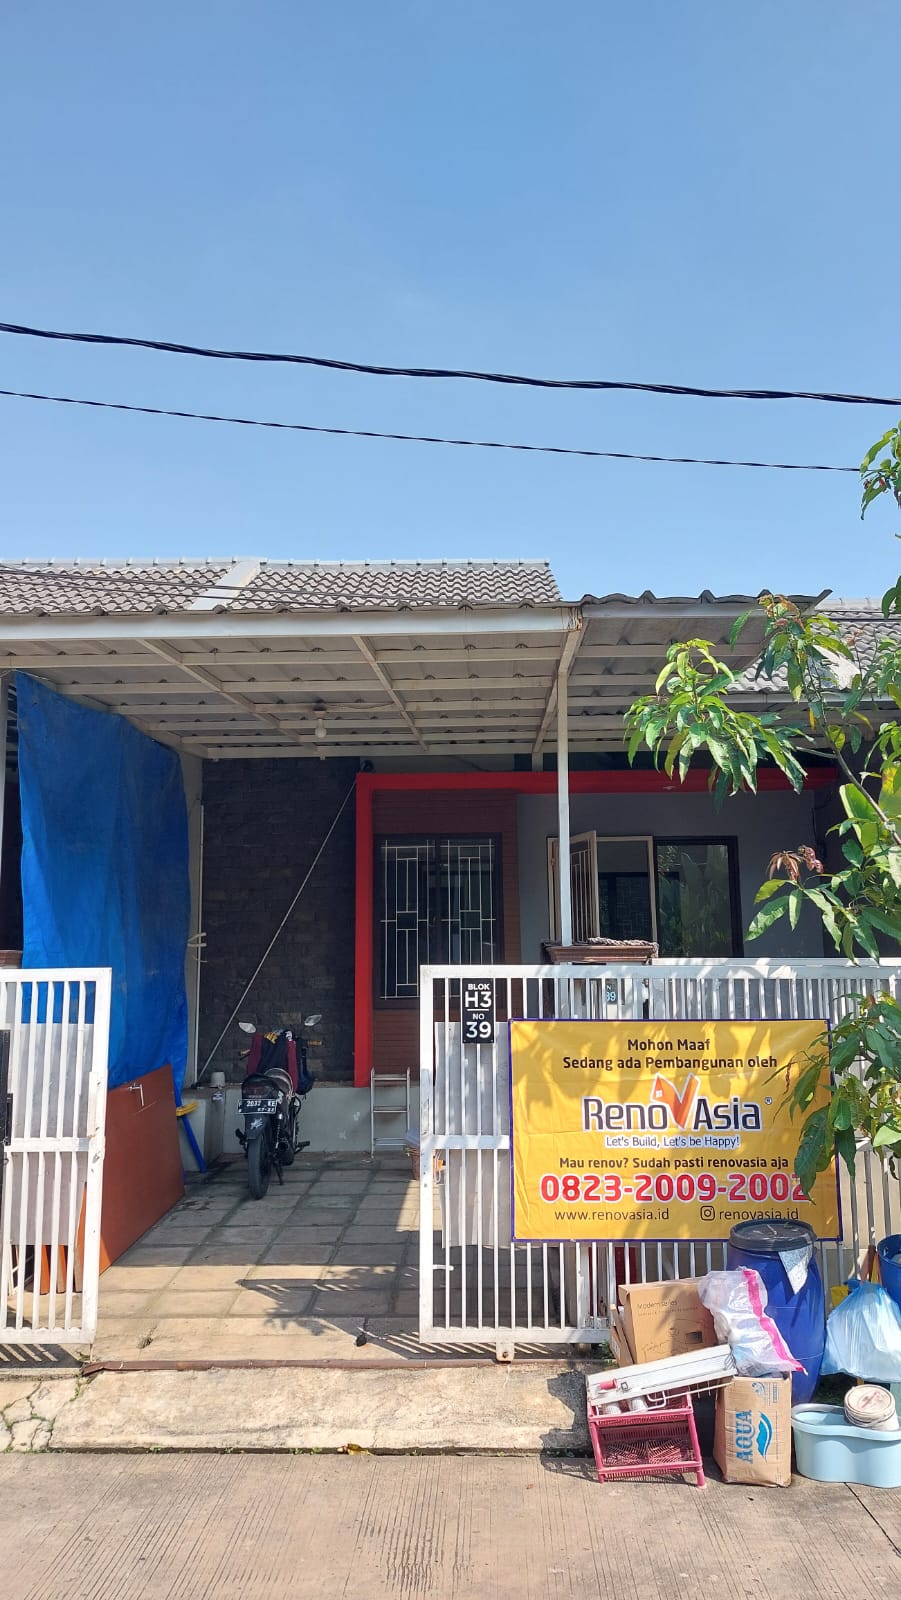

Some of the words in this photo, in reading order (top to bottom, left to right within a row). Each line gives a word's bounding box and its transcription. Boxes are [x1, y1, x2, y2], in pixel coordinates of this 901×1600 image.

[467, 983, 491, 991] BLOK
[464, 991, 492, 1008] H3
[466, 1021, 492, 1038] 39
[627, 1039, 673, 1051] Mohon
[677, 1039, 711, 1051] Maaf
[562, 1057, 613, 1071] Sedang
[617, 1057, 642, 1069] ada
[645, 1056, 744, 1070] Pembangunan
[747, 1056, 778, 1068] oleh
[606, 1136, 630, 1147] Let's
[632, 1136, 661, 1149] Build,
[663, 1136, 687, 1147] Let's
[689, 1136, 702, 1147] be
[704, 1136, 740, 1149] Happy!
[559, 1158, 585, 1169] Mau
[588, 1157, 629, 1169] renov?
[632, 1157, 671, 1169] Sudah
[674, 1157, 704, 1171] pasti
[707, 1157, 768, 1169] renovasia
[770, 1157, 789, 1170] aja
[554, 1207, 670, 1221] www.renovasia.id
[719, 1207, 799, 1220] renovasia.id
[735, 1409, 755, 1464] AQUA
